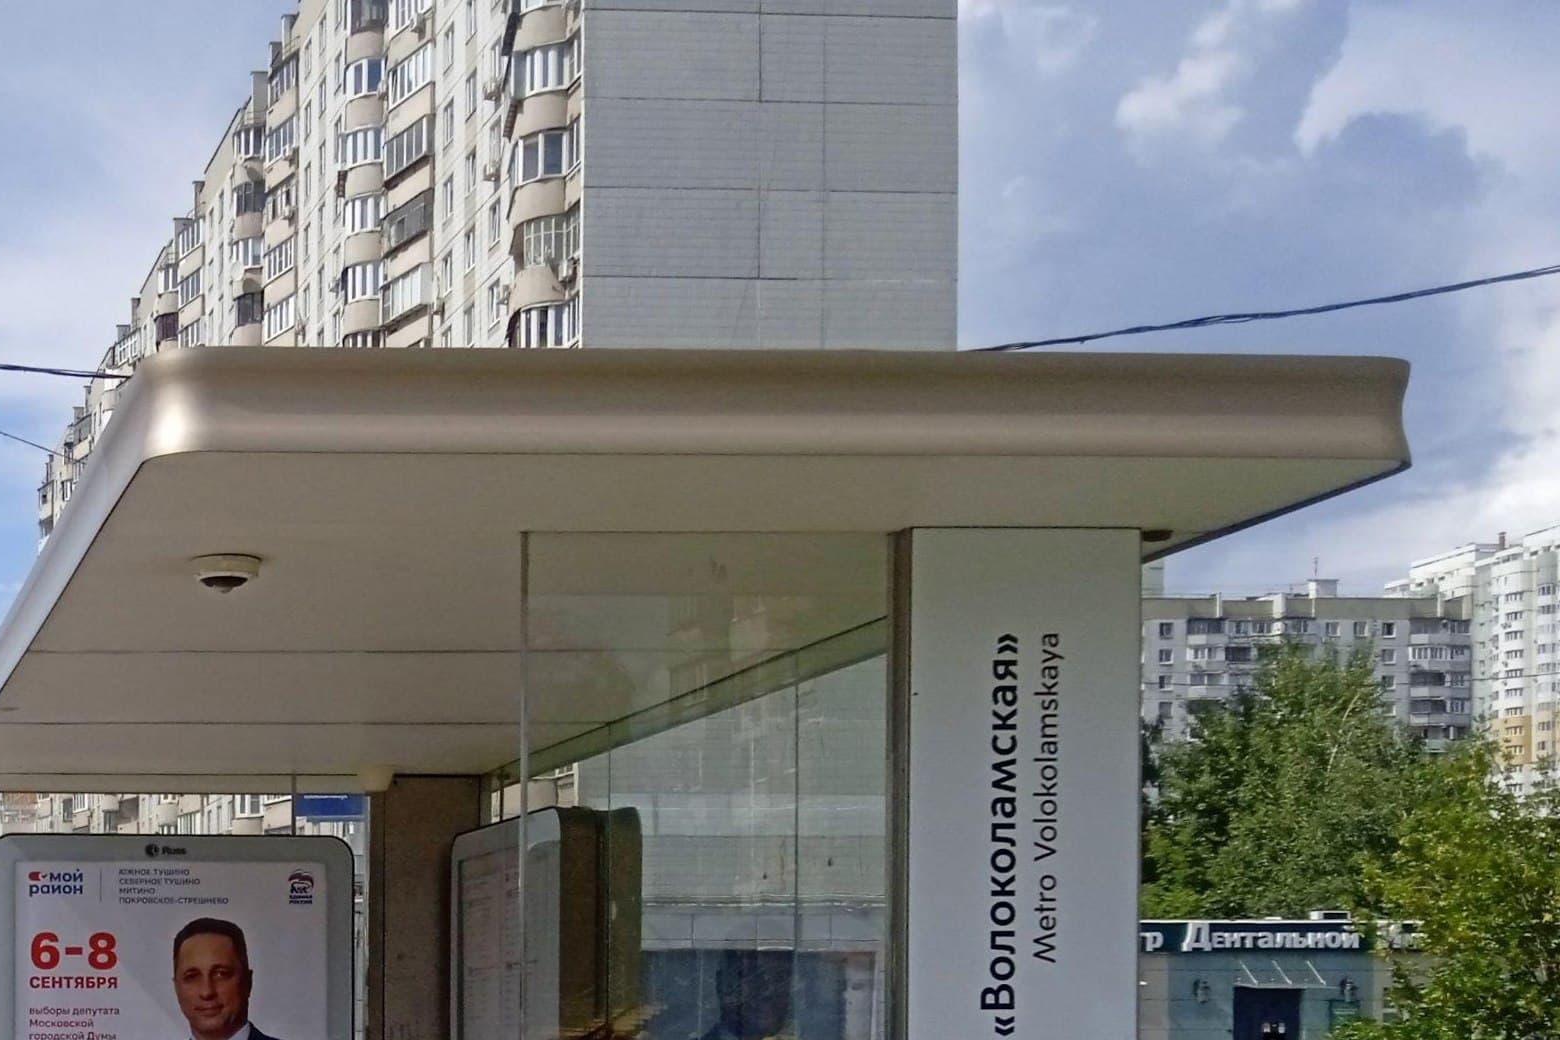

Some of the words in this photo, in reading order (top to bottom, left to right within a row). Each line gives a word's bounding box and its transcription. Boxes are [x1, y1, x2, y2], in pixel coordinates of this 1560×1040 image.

[1033, 632, 1064, 862] Volokolamskaya
[981, 632, 1019, 1037] «Волоколамская»
[164, 878, 200, 886] ТУШИНО
[119, 887, 155, 895] МИТИНО
[1033, 874, 1056, 964] Metro
[1182, 922, 1360, 951] Дентальной
[30, 976, 117, 989] СЕНТЯБРЯ
[29, 1006, 70, 1016] выборы
[72, 1007, 120, 1016] депутата
[29, 1018, 94, 1027] Московской
[87, 1031, 117, 1040] Думы
